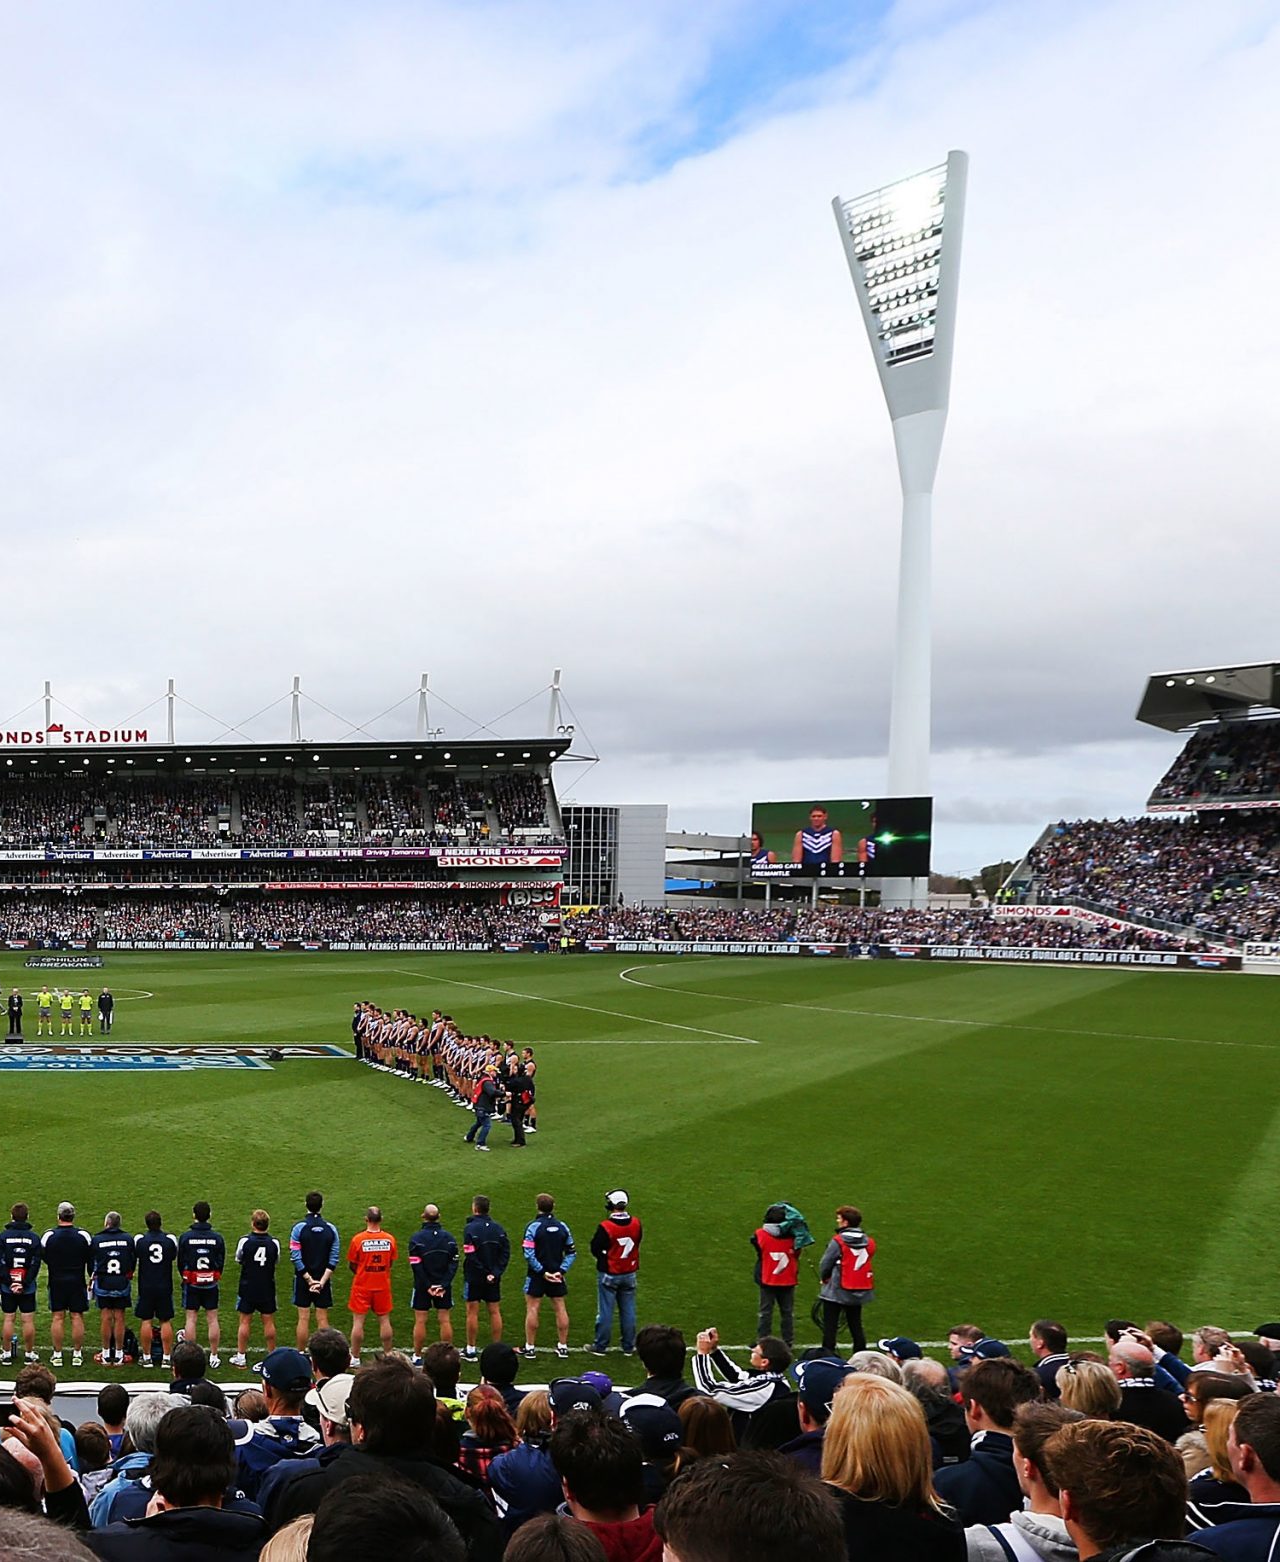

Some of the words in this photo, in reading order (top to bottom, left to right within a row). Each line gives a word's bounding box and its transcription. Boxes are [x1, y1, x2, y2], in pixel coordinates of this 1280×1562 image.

[63, 730, 148, 743] STADIUM
[54, 852, 91, 860] Advertiser
[152, 851, 189, 859] Advertiser
[249, 850, 288, 858] Advertiser
[308, 849, 340, 857] NEXEN
[341, 849, 363, 857] TIRE
[366, 849, 389, 857] Driving
[504, 848, 529, 856] Driving
[439, 857, 530, 865] SIMONDS
[515, 881, 553, 889] SIMONDS
[996, 906, 1051, 916] SIMONDS
[96, 941, 116, 949] GRAND
[116, 941, 133, 949] FINAL
[134, 941, 163, 949] PACKAGES
[164, 941, 195, 949] AVAILABLE
[195, 941, 210, 949] NOW
[210, 941, 219, 949] AT
[219, 941, 254, 949] AFL.COM.AU
[329, 942, 350, 950] GRAND
[350, 942, 365, 950] FINAL
[365, 942, 398, 950] PACKAGES
[399, 942, 431, 950] AVAILABLE
[432, 942, 446, 950] NOW
[447, 942, 455, 950] AT
[615, 943, 637, 951] GRAND
[638, 943, 657, 952] FINAL
[658, 943, 691, 952] PACKAGES
[692, 944, 728, 952] AVAILABLE
[729, 944, 746, 952] NOW
[747, 945, 756, 953] AT
[757, 945, 799, 953] AFL.COM.AU
[930, 947, 958, 957] GRAND
[959, 948, 985, 958] FINAL
[986, 950, 1030, 959] PACKAGES
[1032, 951, 1081, 961] AVAILABLE
[1082, 952, 1105, 962] NOW
[1105, 953, 1118, 962] AT
[1119, 954, 1177, 965] AFL.COM.AU
[65, 1047, 322, 1055] TOYOTA
[616, 1237, 634, 1259] 7
[148, 1243, 163, 1264] 3
[253, 1246, 267, 1266] 4
[769, 1252, 790, 1275] 7
[849, 1248, 869, 1271] 7
